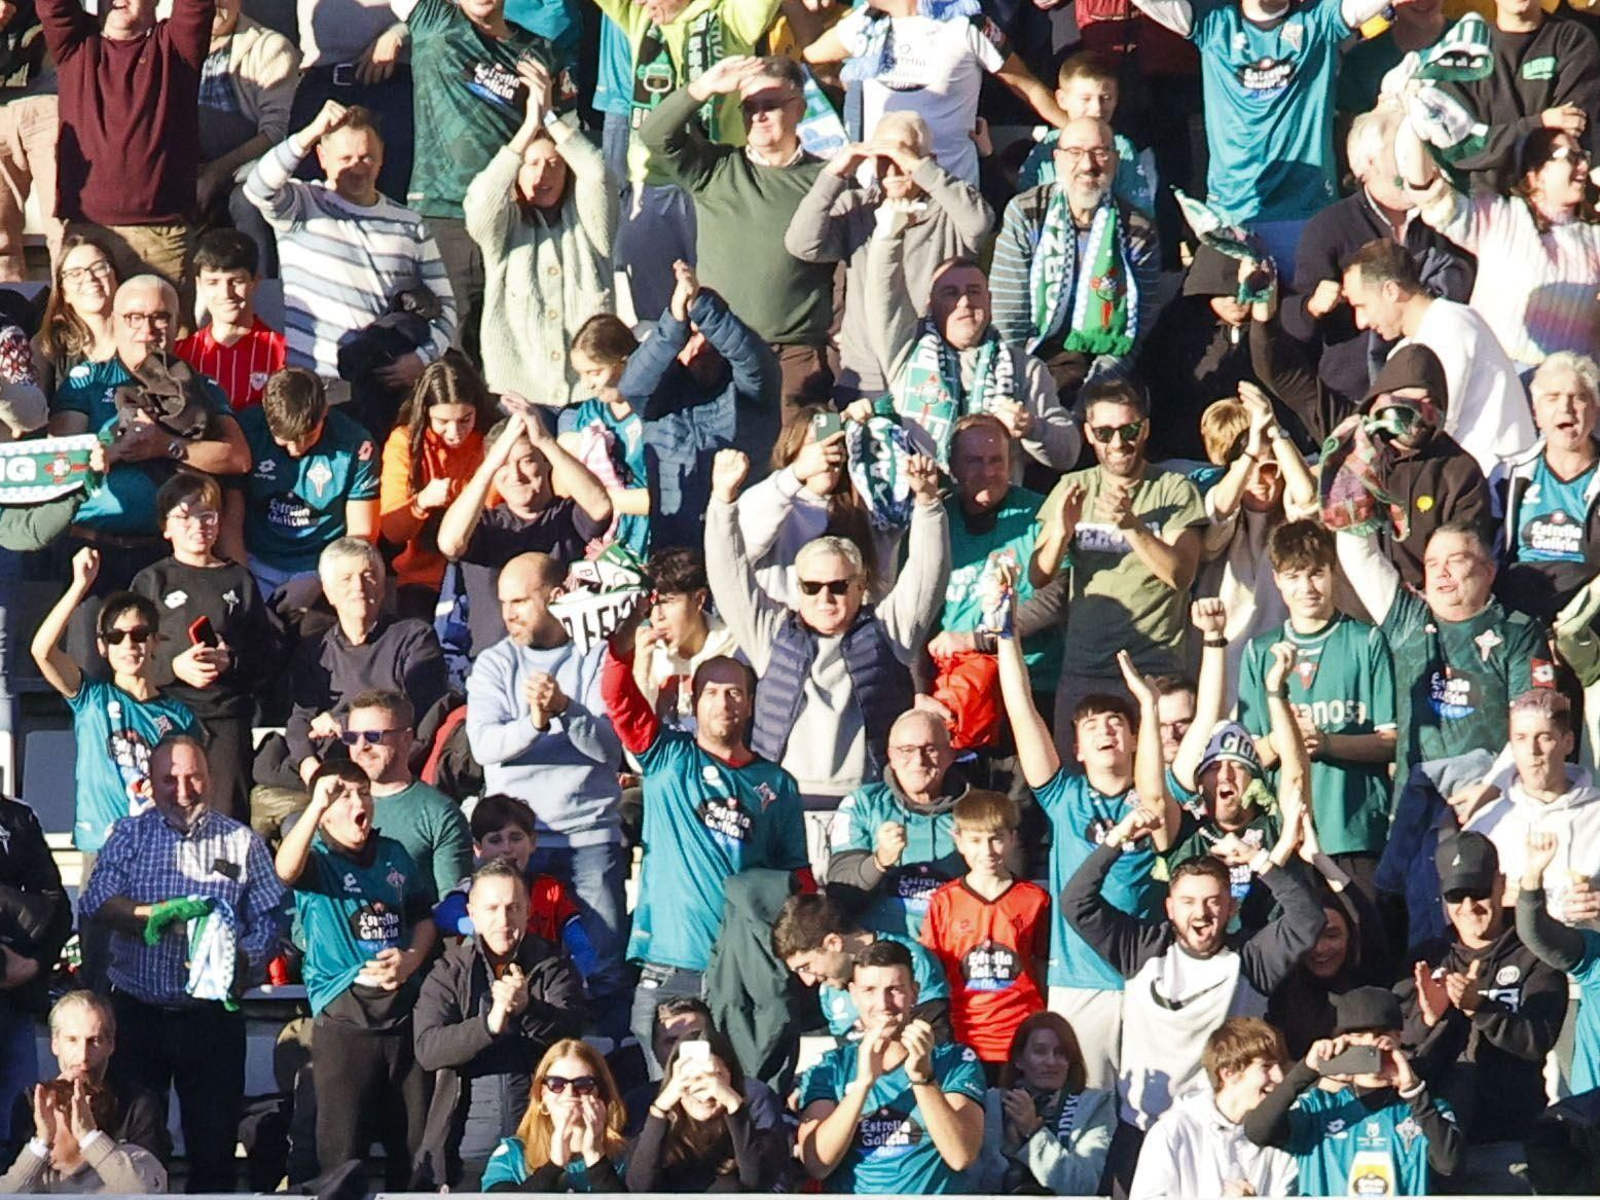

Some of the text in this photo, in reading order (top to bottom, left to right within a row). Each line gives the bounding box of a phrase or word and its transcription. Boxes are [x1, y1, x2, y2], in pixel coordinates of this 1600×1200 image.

[1531, 520, 1583, 540] Estrella
[1532, 535, 1580, 552] Galicia
[860, 1119, 911, 1133] Estrella
[862, 1131, 909, 1147] Galicia
